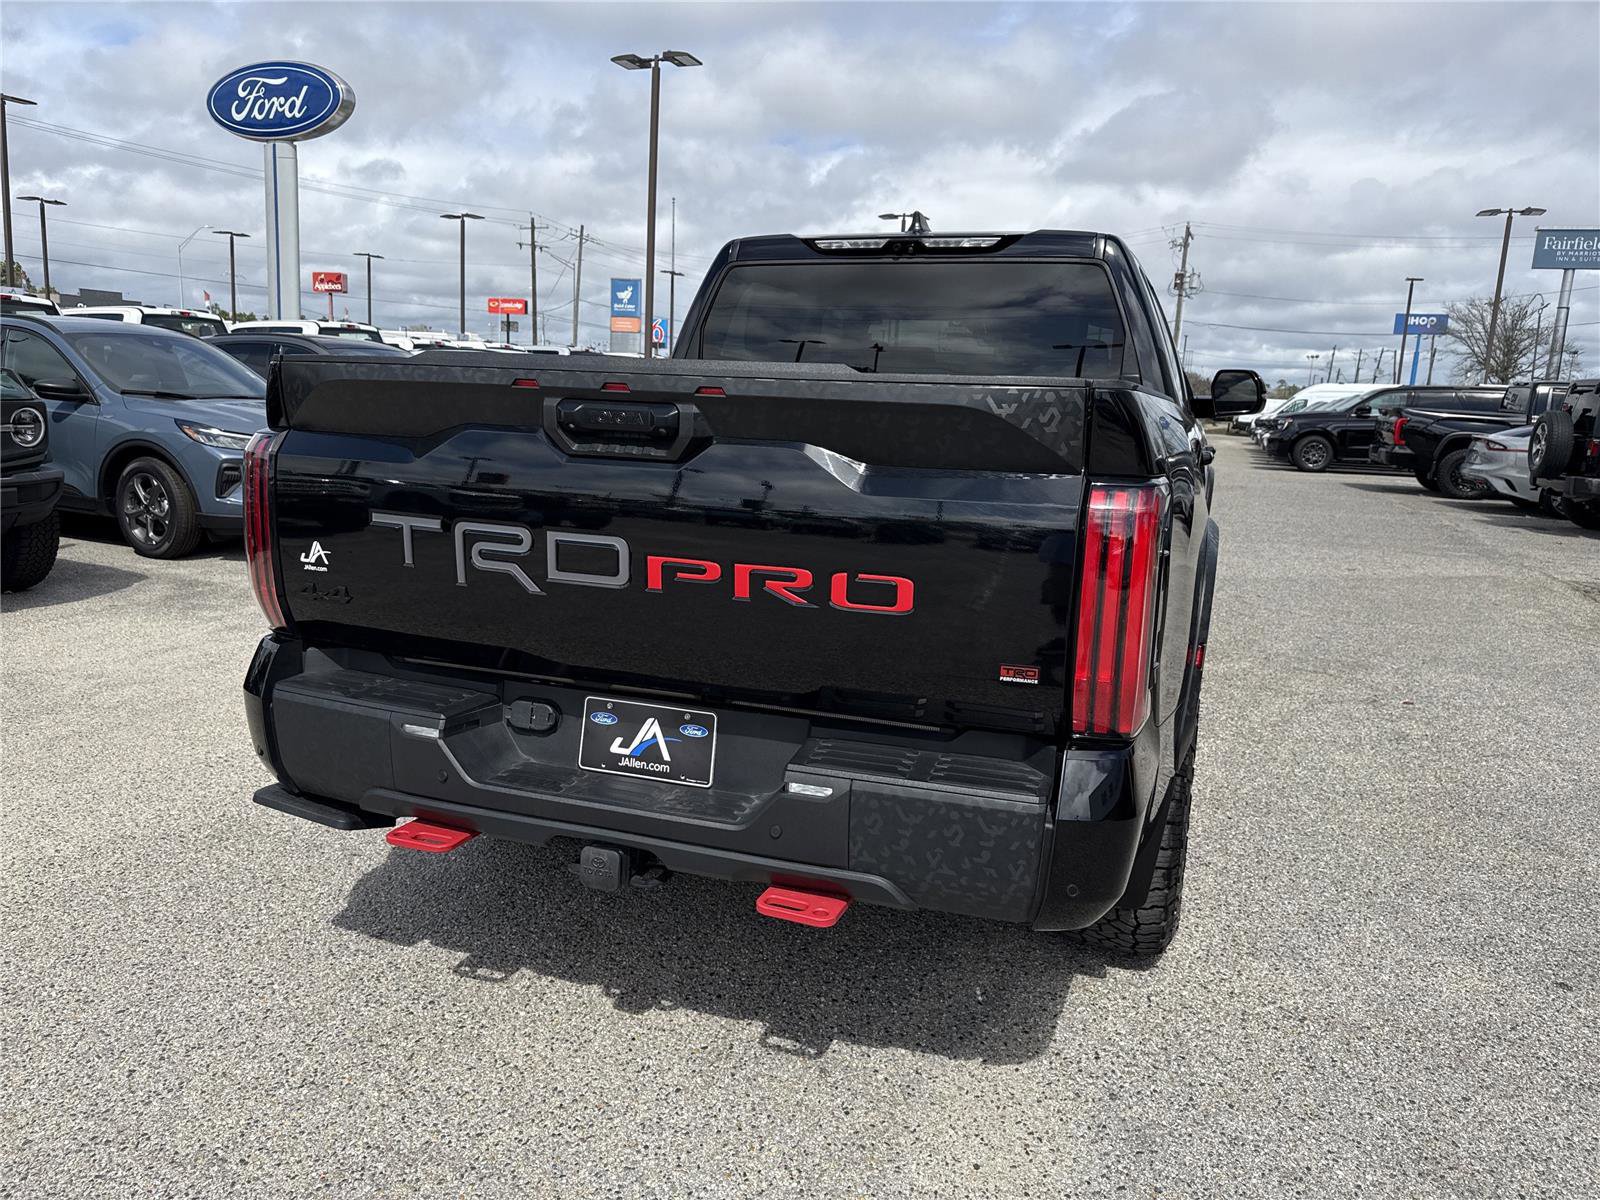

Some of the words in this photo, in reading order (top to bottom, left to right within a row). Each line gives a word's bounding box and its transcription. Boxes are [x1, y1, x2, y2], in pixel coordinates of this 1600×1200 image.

[231, 76, 308, 121] Ford
[652, 318, 665, 344] 6
[370, 509, 630, 596] TRD
[645, 555, 914, 616] PRO
[1000, 665, 1039, 679] TRD
[999, 676, 1039, 685] PERFORMANCE
[595, 713, 612, 723] Ford
[684, 725, 703, 736] Ford
[618, 756, 671, 773] JAllen.com
